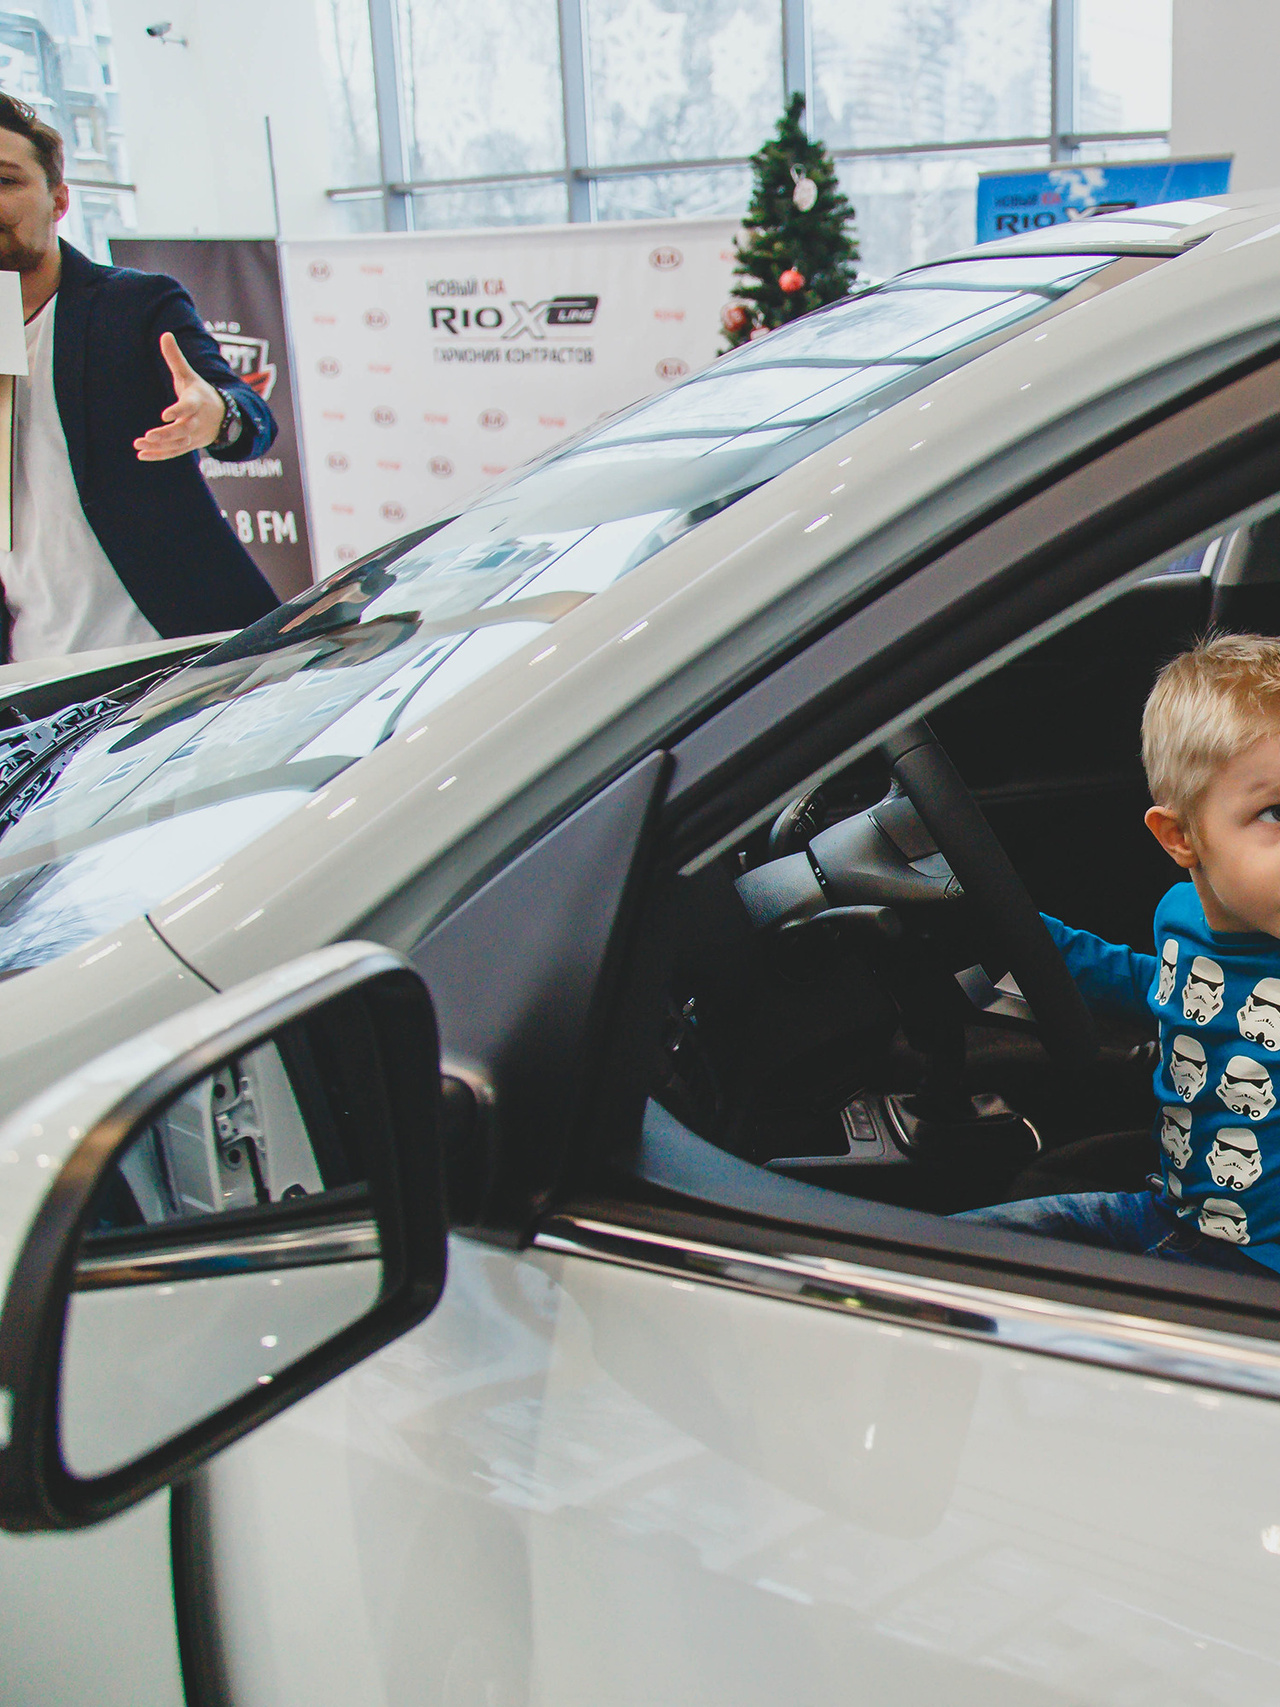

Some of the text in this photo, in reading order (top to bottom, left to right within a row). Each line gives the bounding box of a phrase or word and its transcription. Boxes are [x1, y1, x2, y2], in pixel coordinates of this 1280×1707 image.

[996, 211, 1056, 234] RIO
[430, 306, 503, 335] RIO
[257, 510, 298, 544] FM
